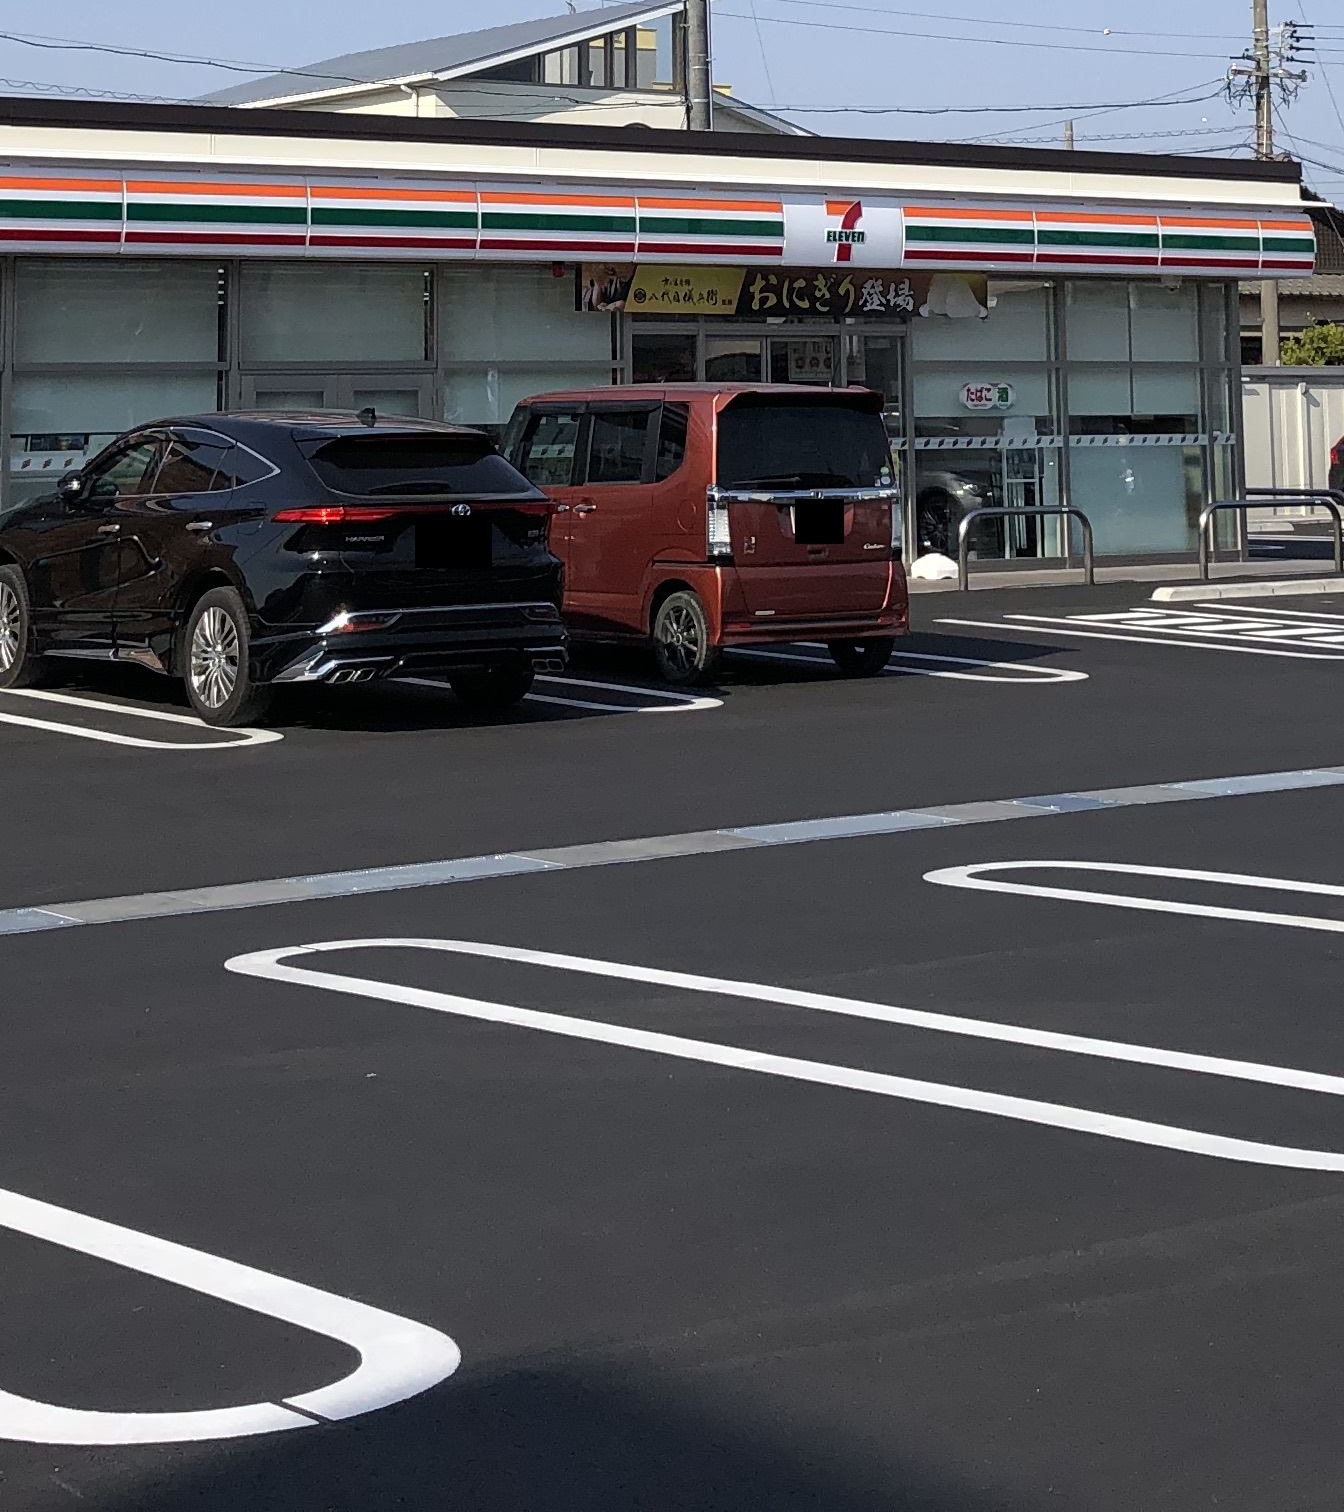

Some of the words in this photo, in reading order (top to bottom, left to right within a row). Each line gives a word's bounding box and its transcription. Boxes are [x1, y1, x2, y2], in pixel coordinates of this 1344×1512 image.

[825, 200, 863, 262] 7
[749, 273, 915, 314] おにぎり登場
[966, 386, 993, 403] たばこ
